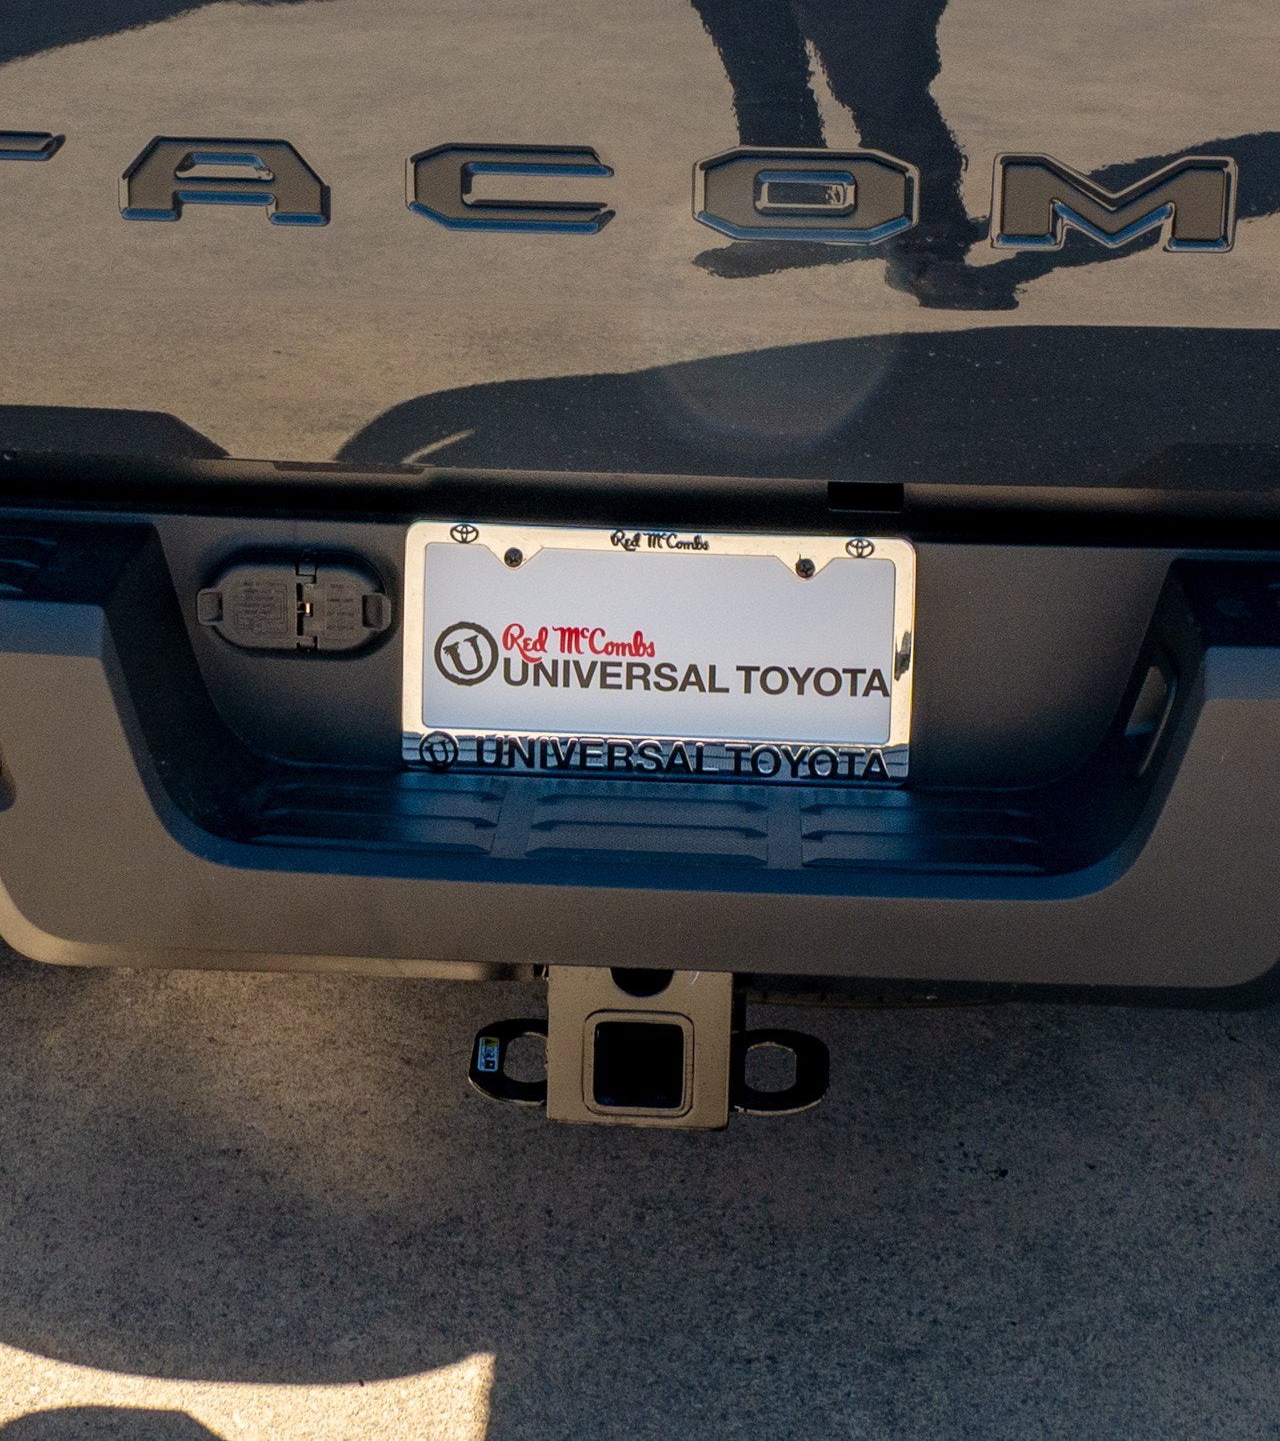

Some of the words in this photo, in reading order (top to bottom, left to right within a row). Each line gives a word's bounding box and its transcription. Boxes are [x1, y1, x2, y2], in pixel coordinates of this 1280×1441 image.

[611, 529, 640, 552] Red
[502, 623, 548, 663] Red
[553, 626, 656, 658] McCombs
[503, 656, 729, 695] UNIVERSAL
[737, 665, 891, 698] TOYOTA
[476, 735, 719, 775] UNIVERSAL
[726, 743, 891, 780] TOYOTA
